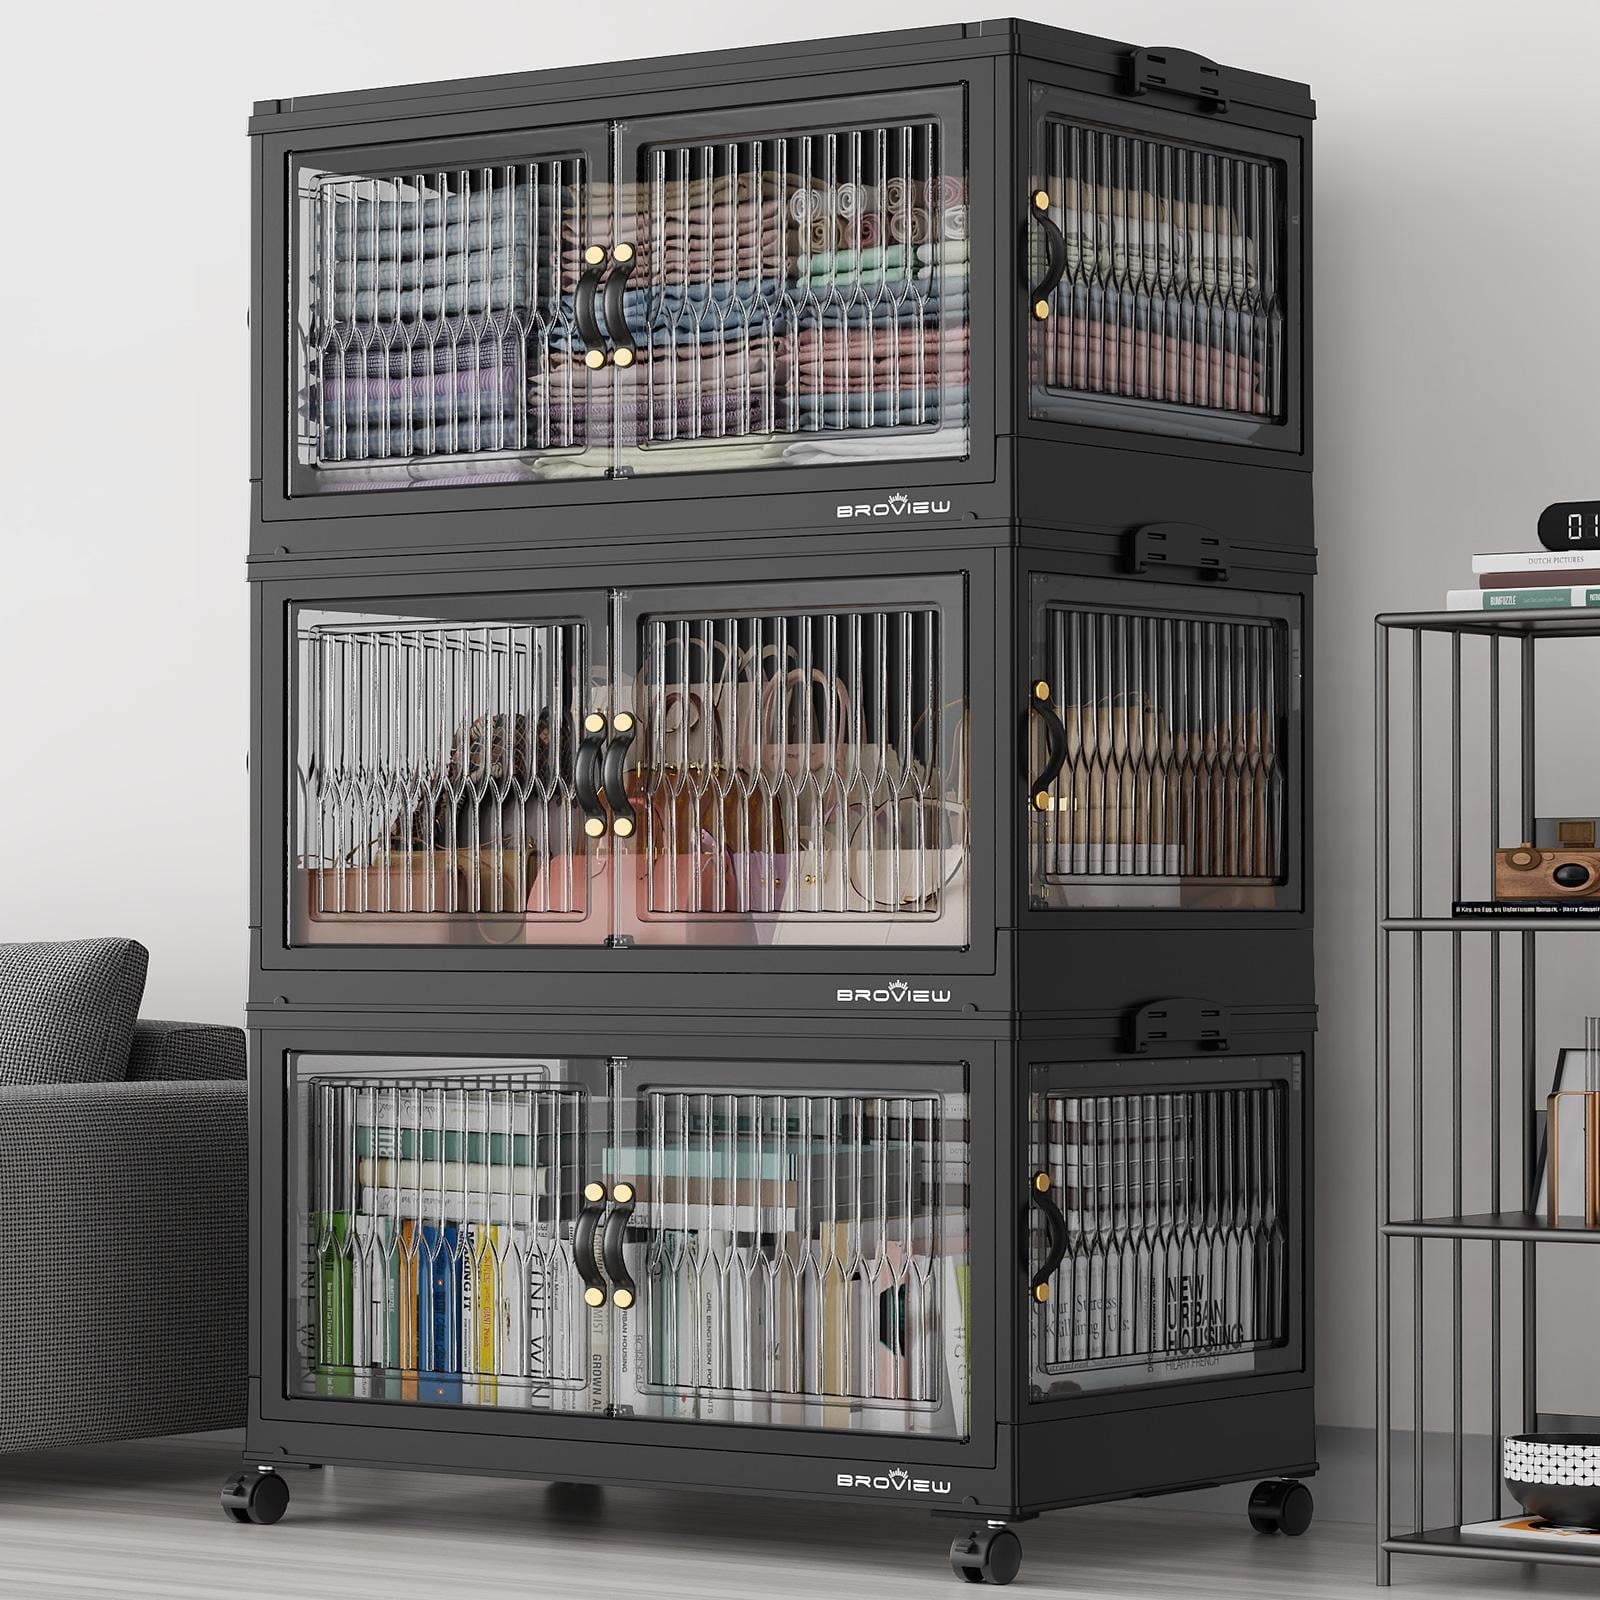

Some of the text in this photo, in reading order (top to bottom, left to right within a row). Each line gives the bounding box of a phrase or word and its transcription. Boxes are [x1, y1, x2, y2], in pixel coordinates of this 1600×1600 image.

[837, 498, 951, 518] BROVIEW
[1528, 556, 1584, 565] DUTCH PICTURES
[837, 987, 951, 1002] BROVIEW
[1168, 1274, 1204, 1303] NEW
[1168, 1299, 1223, 1330] URBAN
[1166, 1322, 1244, 1357] HOUSING
[592, 1353, 603, 1395] GROWN
[837, 1472, 951, 1494] BROVIEW
